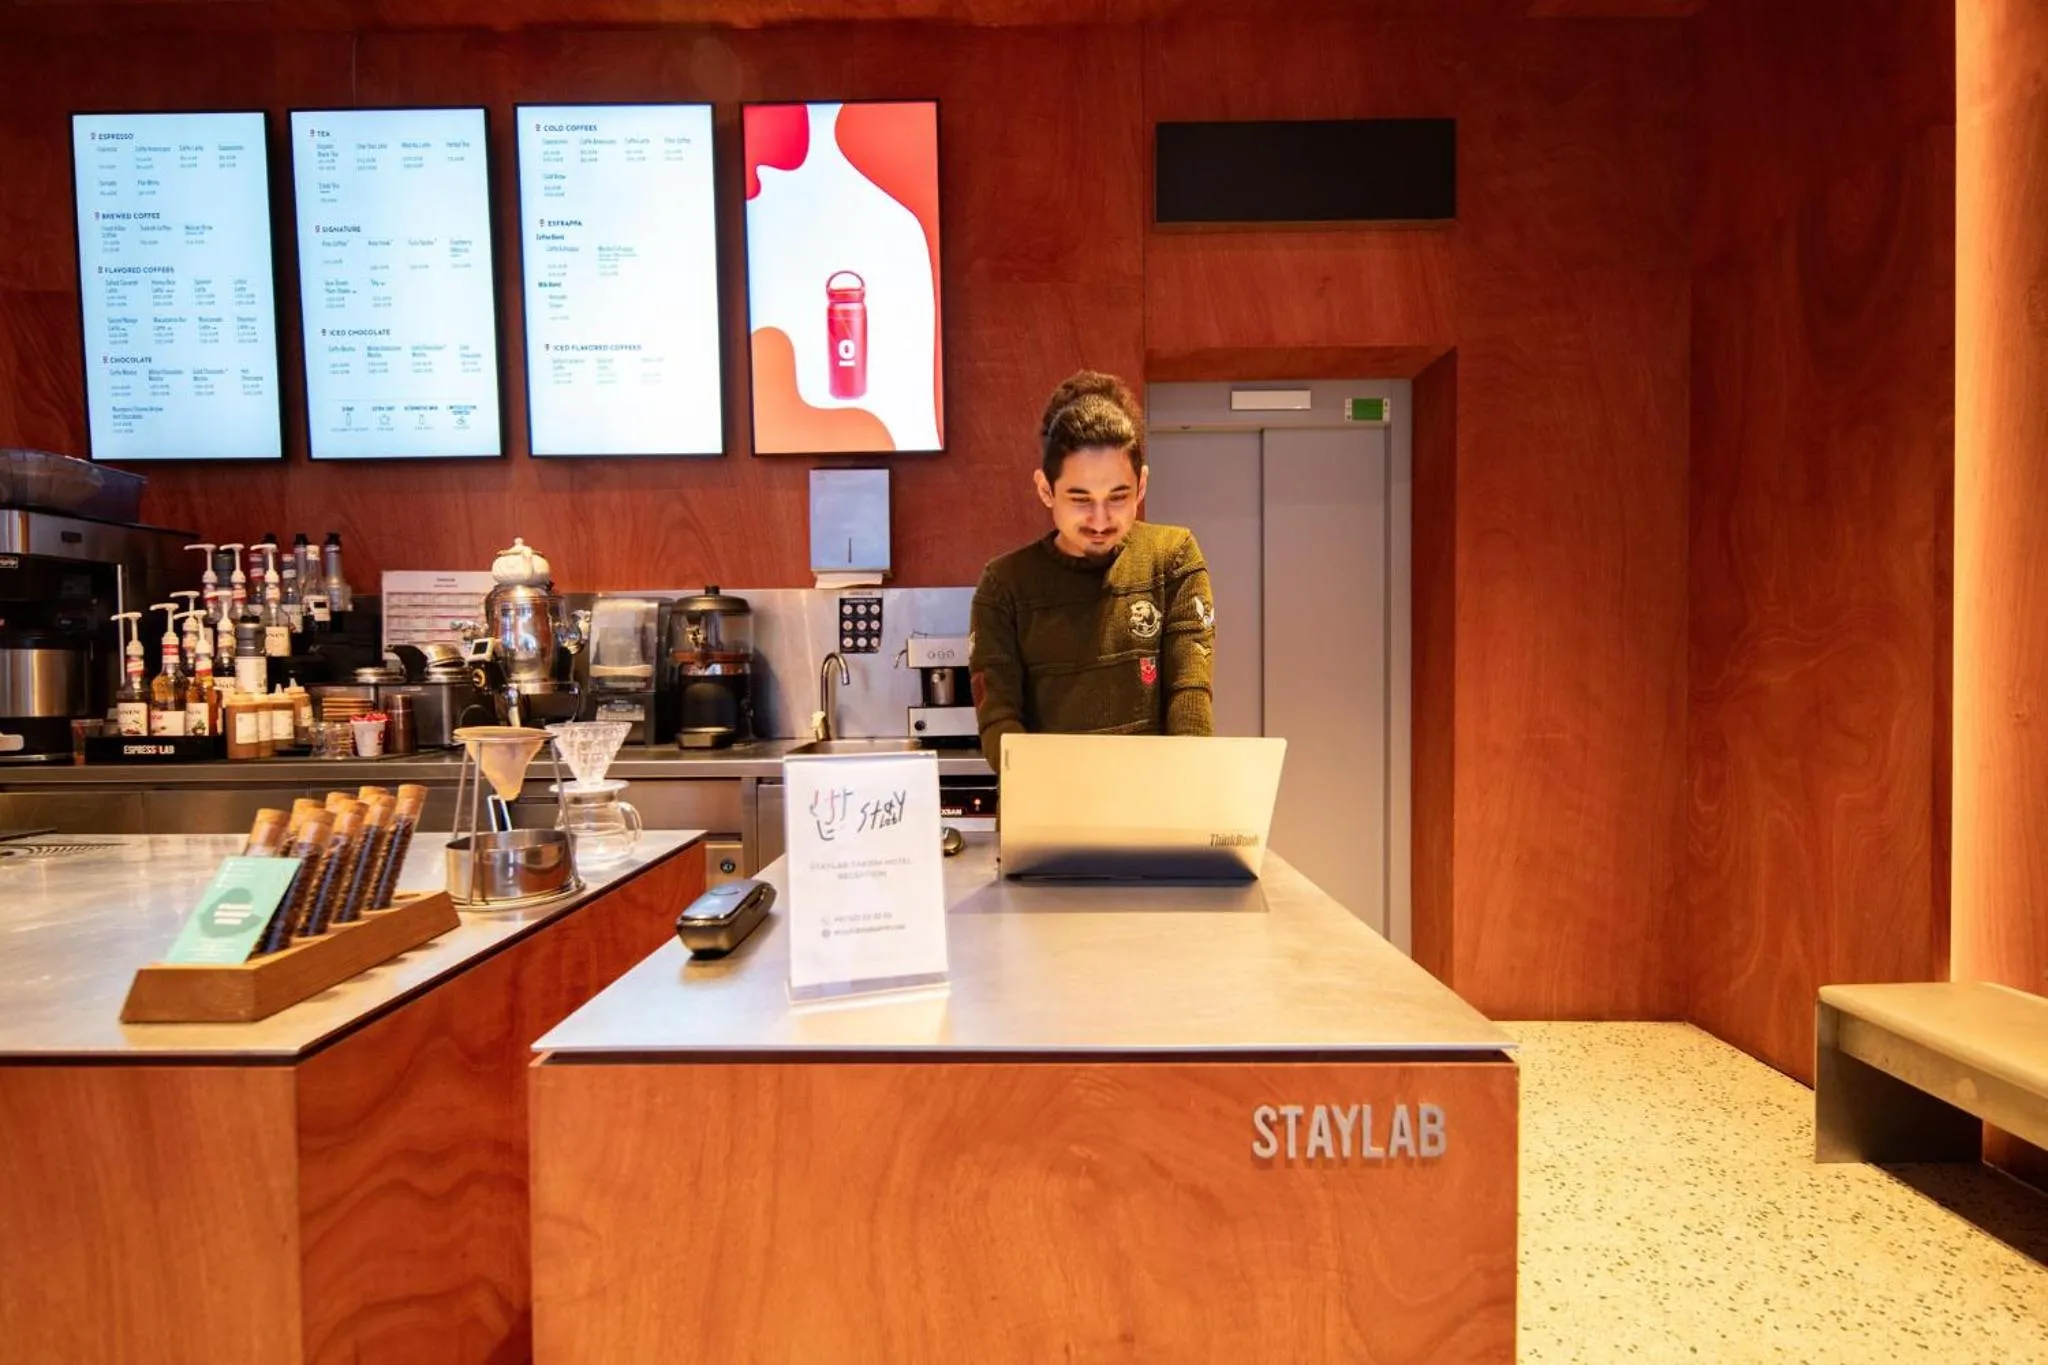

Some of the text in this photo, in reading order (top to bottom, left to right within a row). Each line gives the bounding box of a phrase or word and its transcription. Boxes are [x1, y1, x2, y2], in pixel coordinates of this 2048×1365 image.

[104, 266, 141, 274] FLAVORED
[1210, 833, 1259, 848] ThinkBook
[1252, 1102, 1447, 1159] STAYLAB
